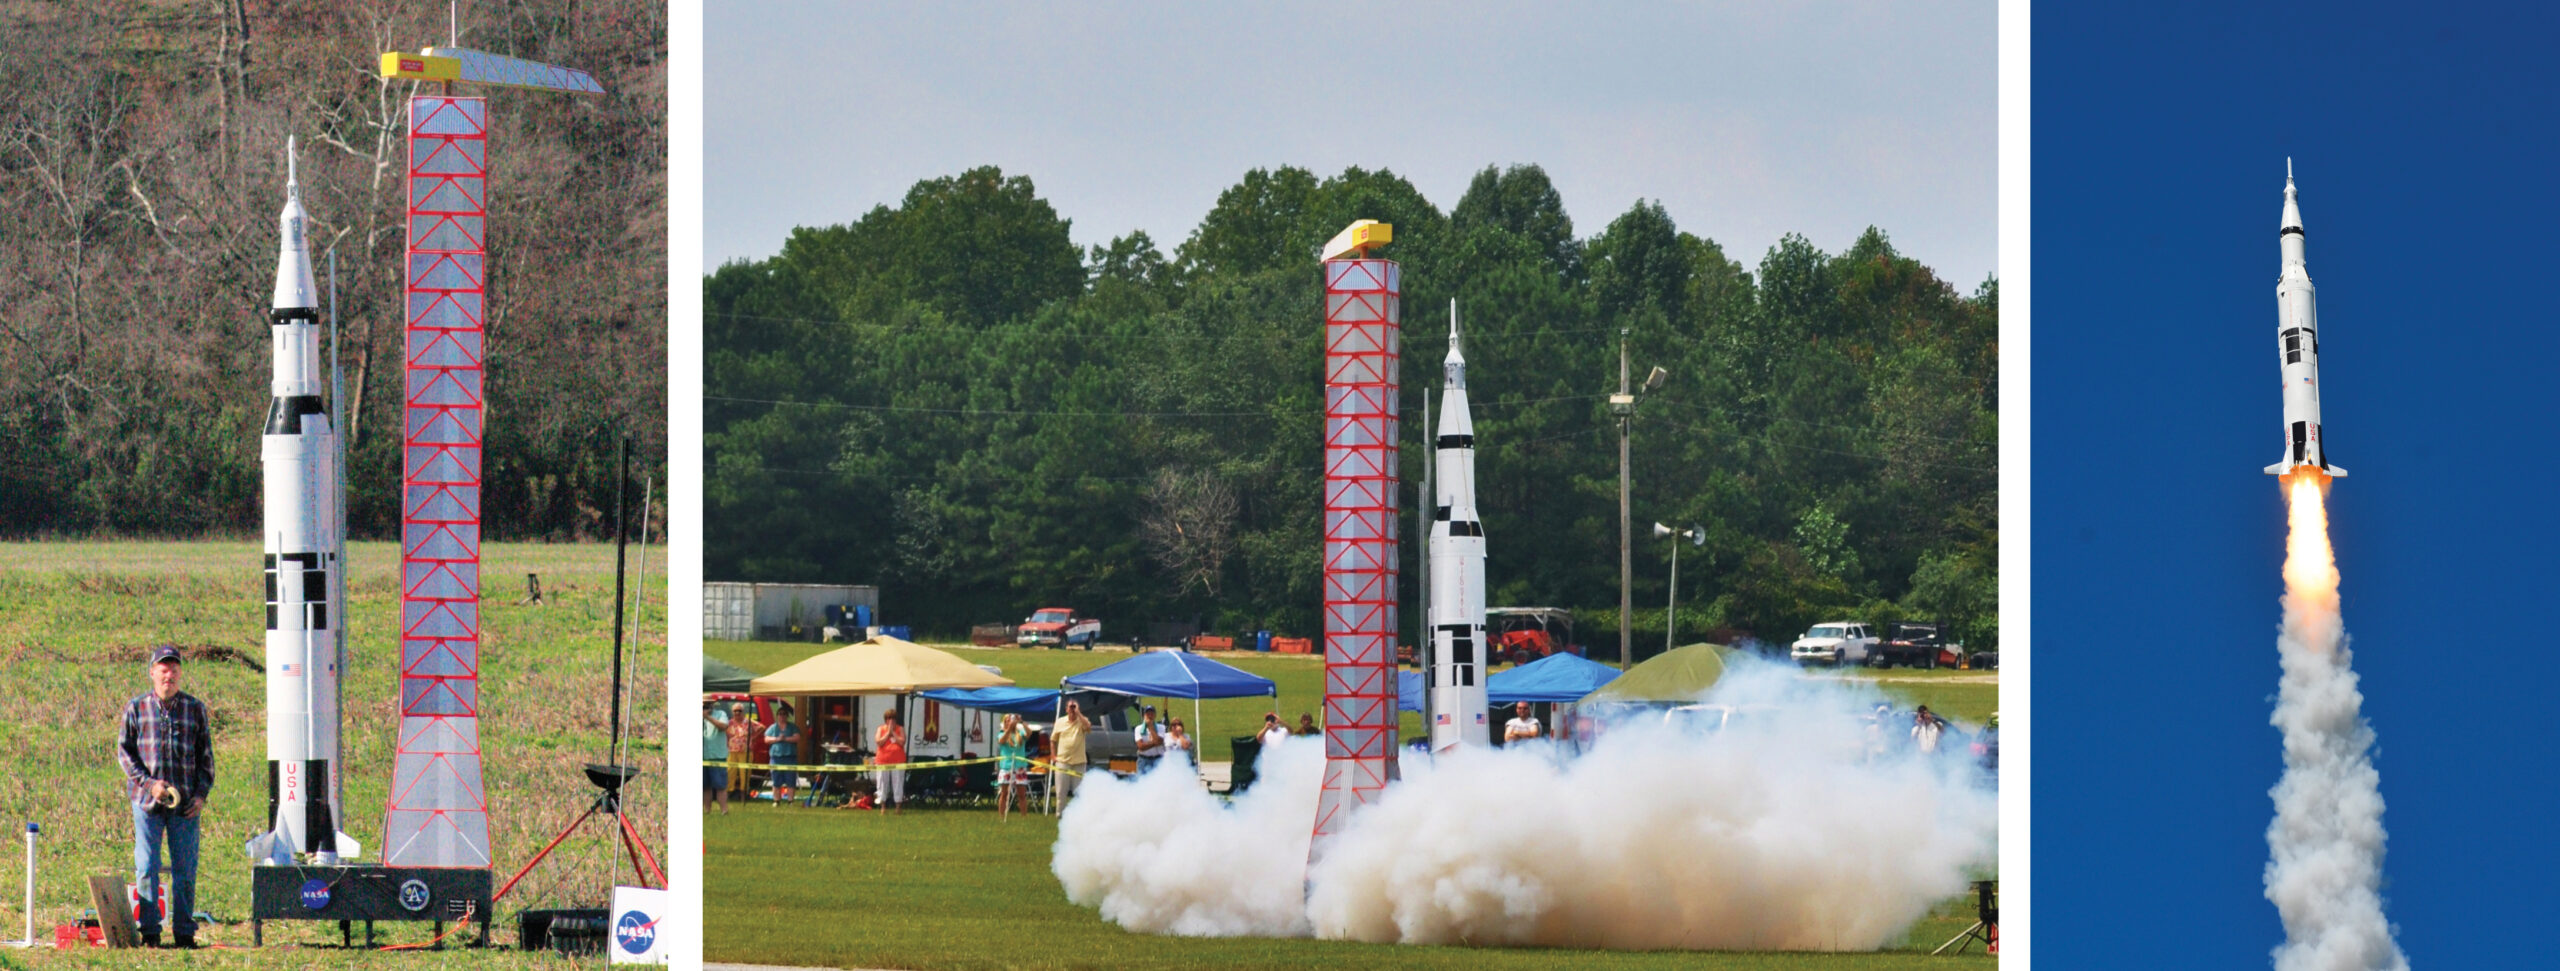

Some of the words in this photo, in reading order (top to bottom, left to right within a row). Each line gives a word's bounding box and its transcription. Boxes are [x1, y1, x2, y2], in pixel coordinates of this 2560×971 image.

[914, 734, 949, 745] SOR
[286, 763, 297, 802] USA
[303, 890, 329, 898] NASA
[407, 886, 422, 902] A
[618, 926, 654, 938] NASA
